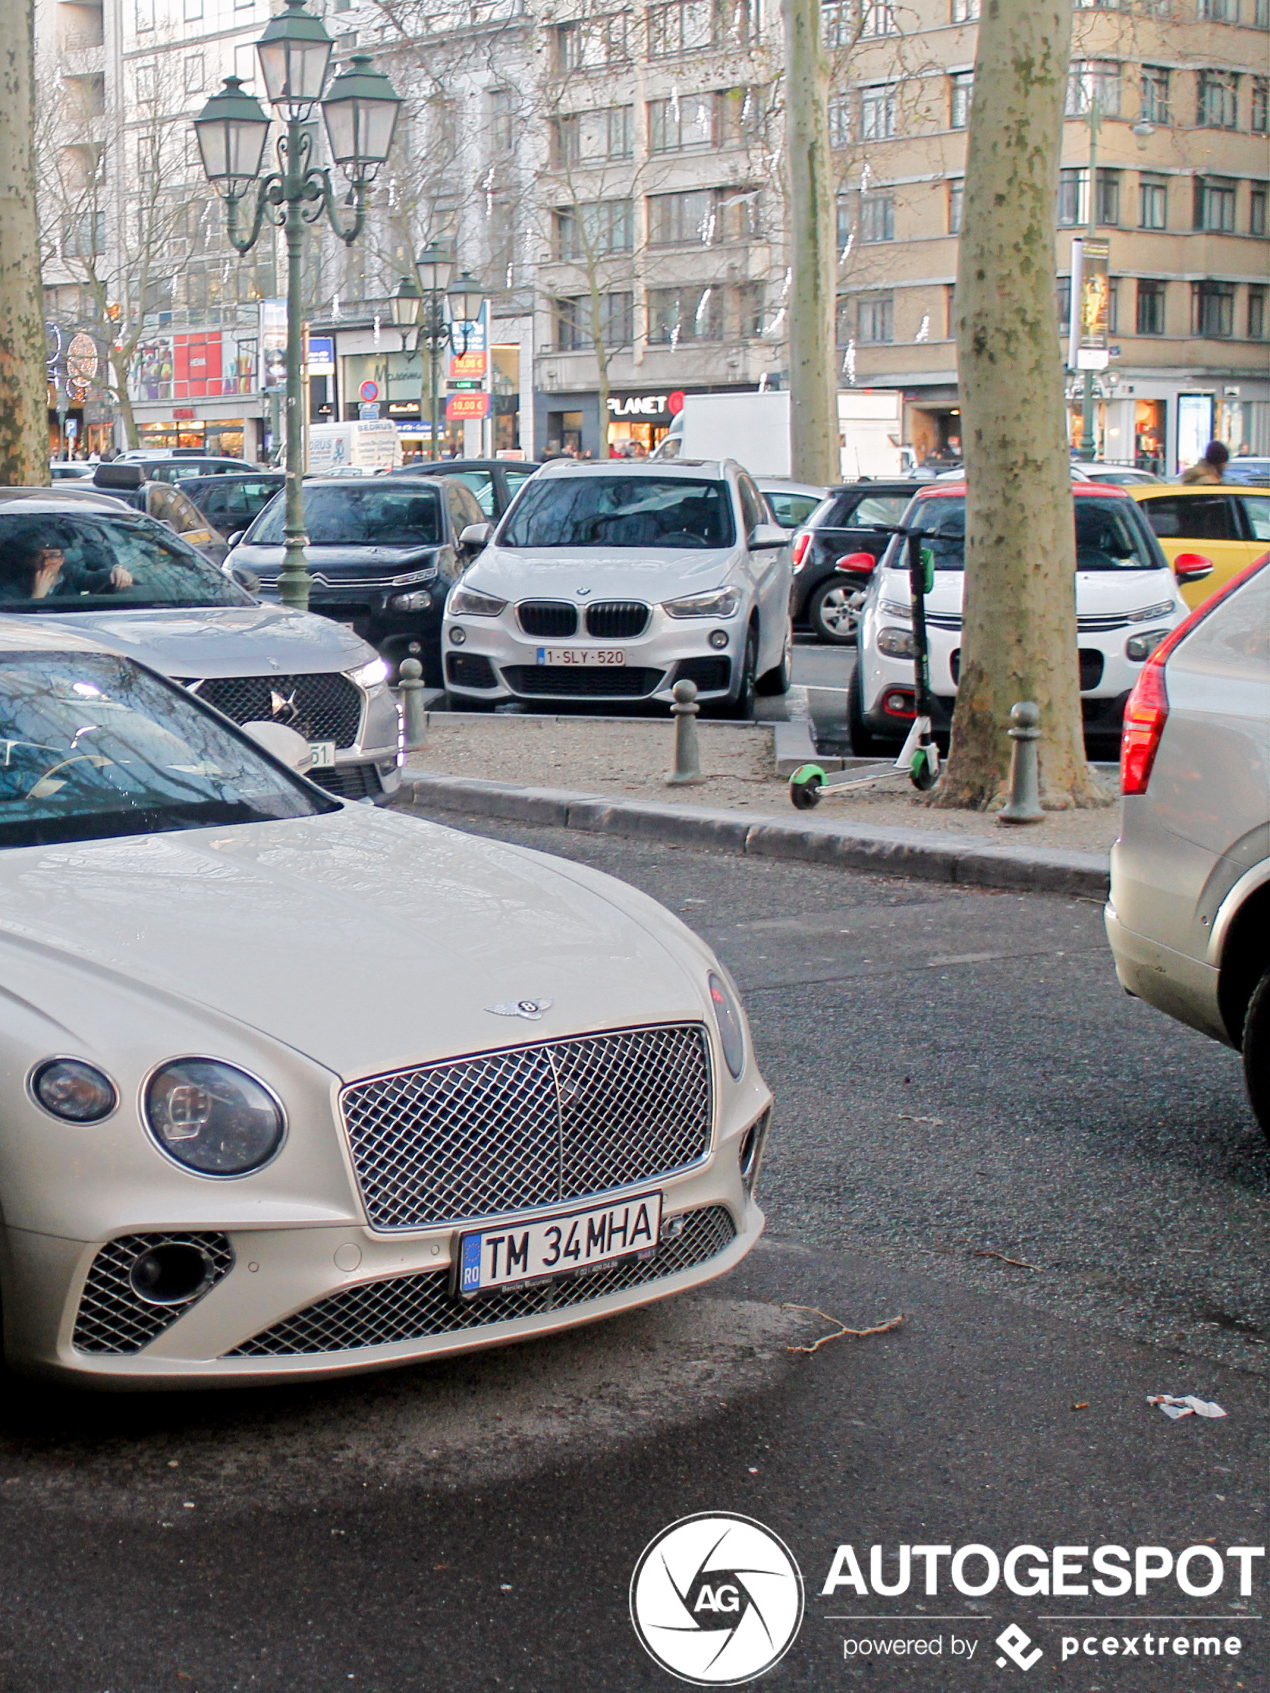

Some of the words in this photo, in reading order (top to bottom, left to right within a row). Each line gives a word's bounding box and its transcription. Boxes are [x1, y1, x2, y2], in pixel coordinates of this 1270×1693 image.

[453, 400, 476, 411] 10,00
[547, 651, 624, 664] 1-SLY-520
[486, 1231, 530, 1279] TM
[542, 1220, 581, 1267] 34
[586, 1202, 652, 1258] MHA
[464, 1266, 479, 1285] RO
